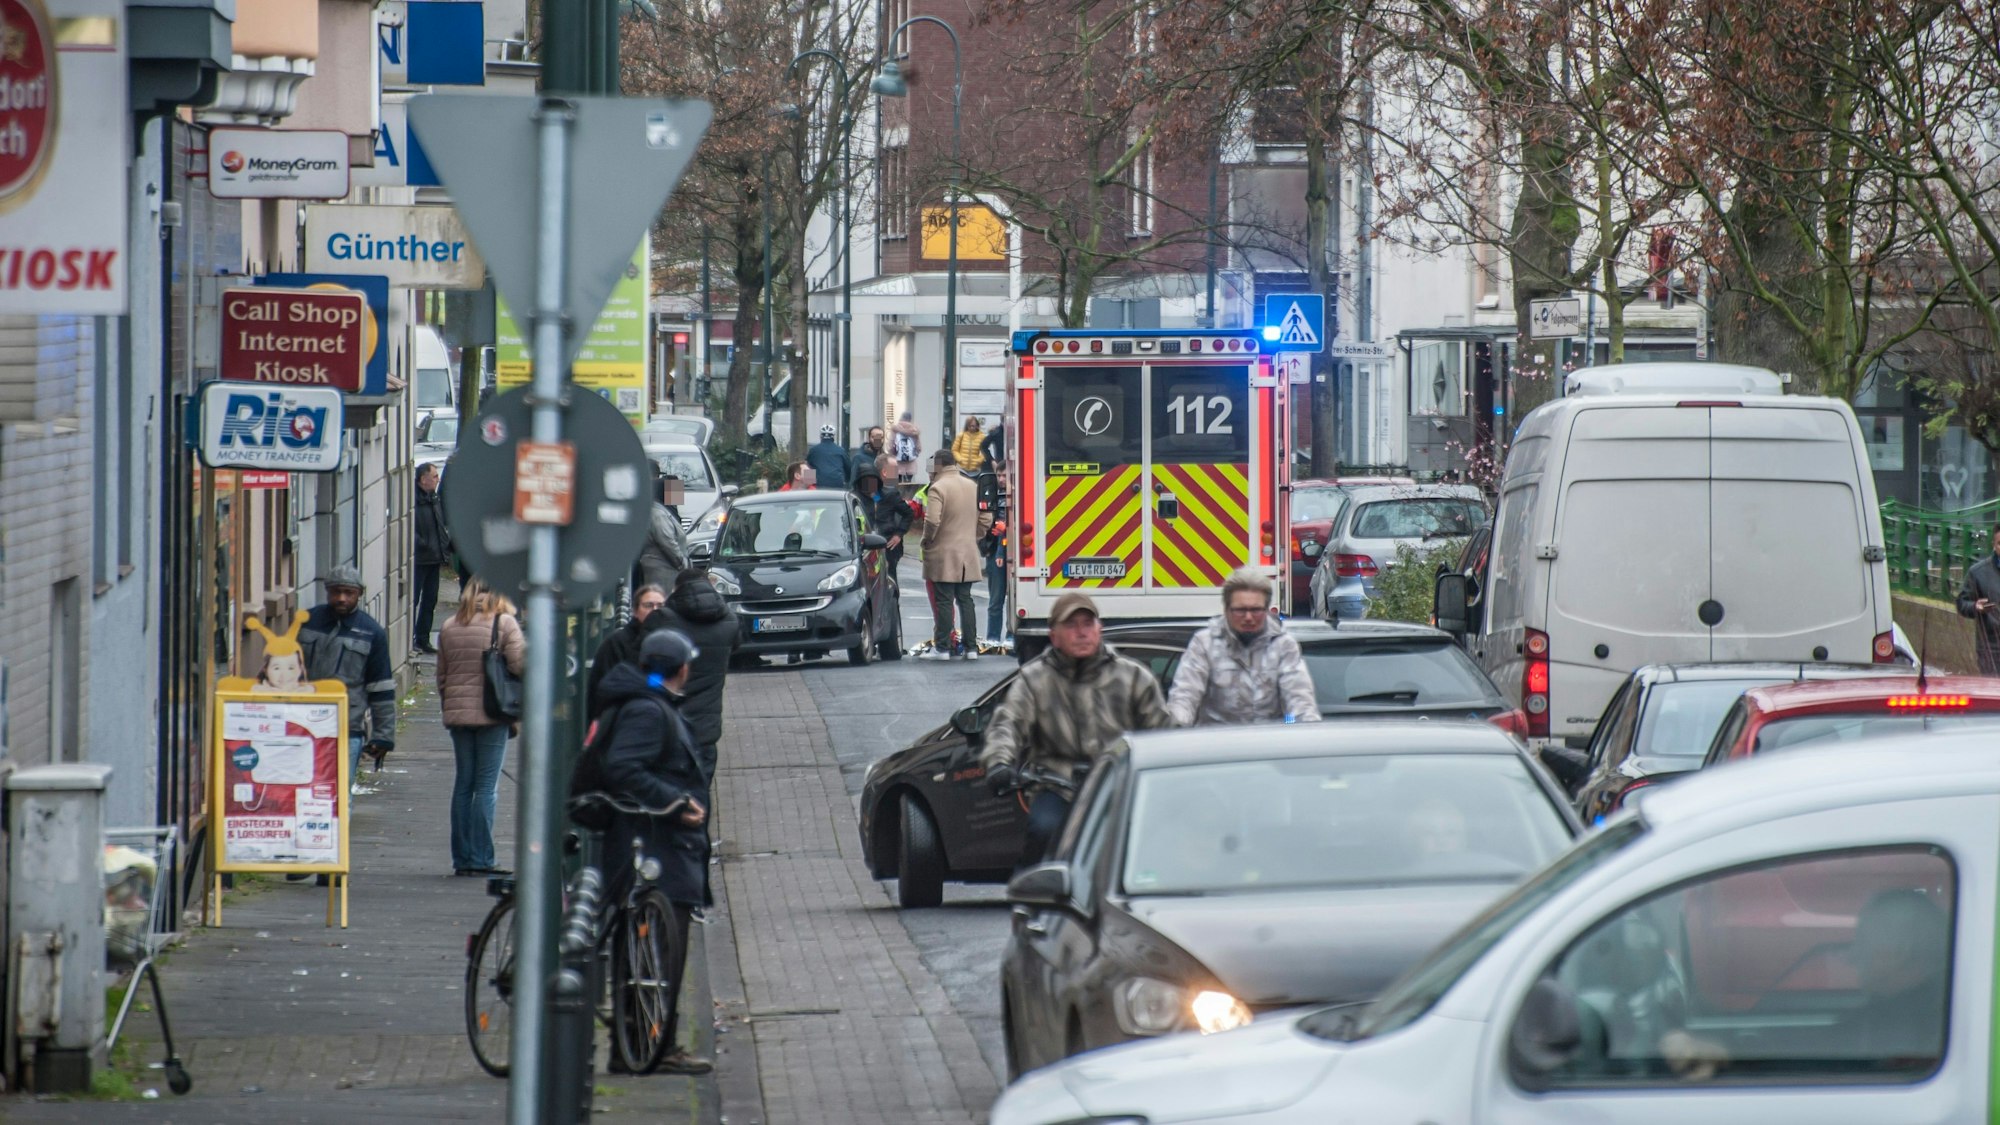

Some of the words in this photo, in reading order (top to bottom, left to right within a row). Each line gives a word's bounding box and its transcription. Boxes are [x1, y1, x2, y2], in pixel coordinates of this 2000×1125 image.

[248, 158, 337, 174] MoneyGram
[928, 213, 967, 228] ADC
[327, 232, 464, 262] Günther
[0, 248, 117, 290] IOSK
[228, 300, 279, 322] Call
[289, 302, 358, 328] Shop
[239, 331, 346, 354] Internet
[254, 362, 329, 383] Kiosk
[218, 392, 328, 450] Ria
[1166, 395, 1233, 434] 112
[216, 450, 263, 461] MONEY
[265, 451, 322, 464] TRANSFER
[1069, 564, 1087, 575] LEV
[1093, 564, 1105, 575] RD
[1107, 564, 1124, 575] 847
[227, 820, 284, 830] EINSTECKEN
